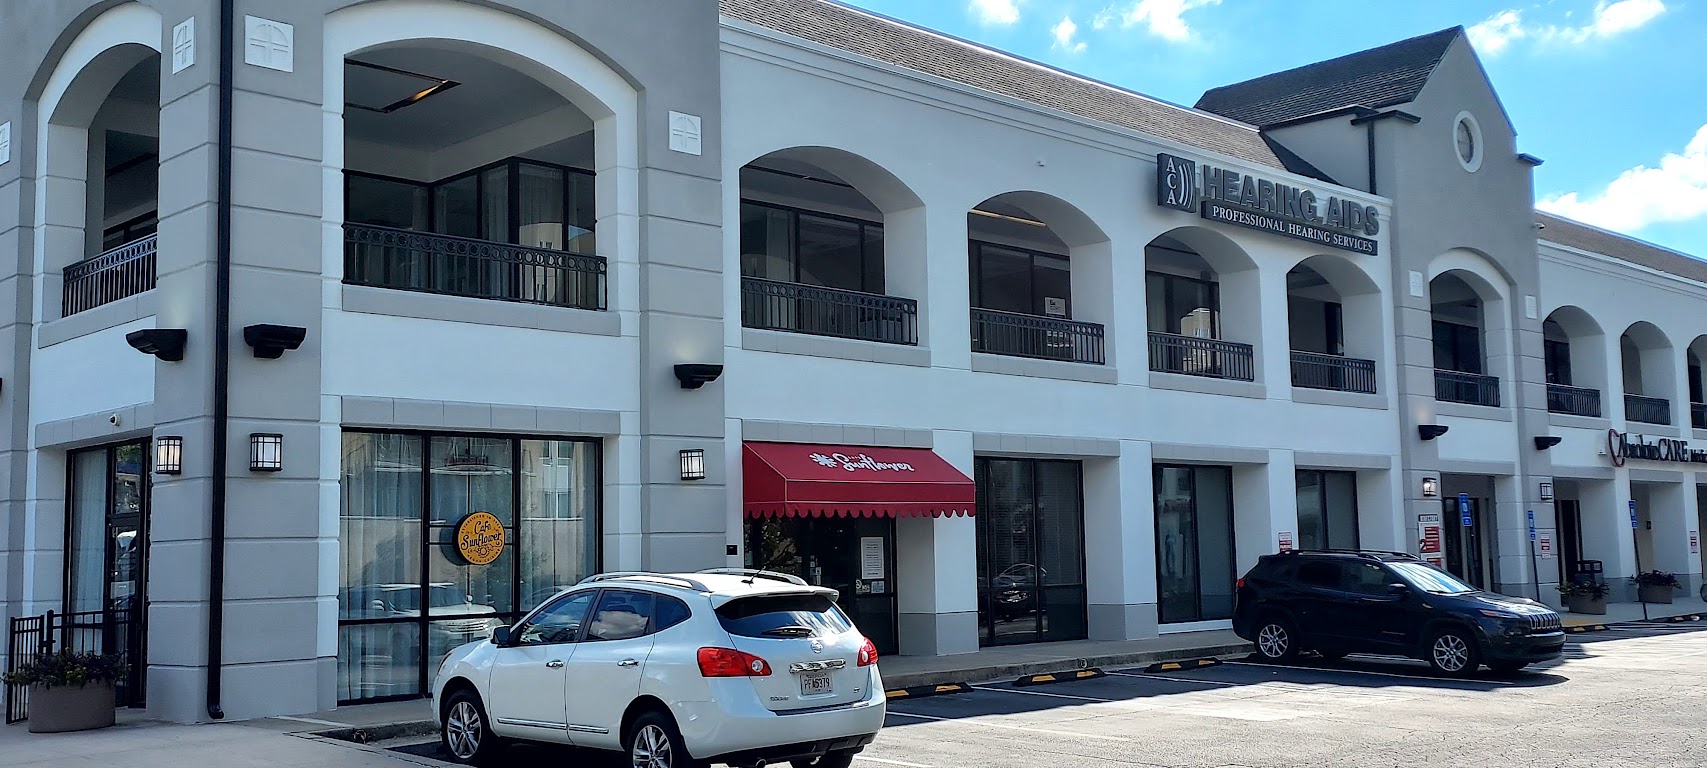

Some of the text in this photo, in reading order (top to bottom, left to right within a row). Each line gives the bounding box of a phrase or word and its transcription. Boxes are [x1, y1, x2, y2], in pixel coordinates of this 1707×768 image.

[1166, 157, 1178, 206] ACA
[1202, 164, 1380, 236] HEARING AIDS
[1212, 205, 1373, 252] PROFESSIONAL HEARING SERVICES
[832, 452, 915, 472] Sunflower
[460, 532, 502, 550] Sunflower
[474, 520, 492, 535] Cafe
